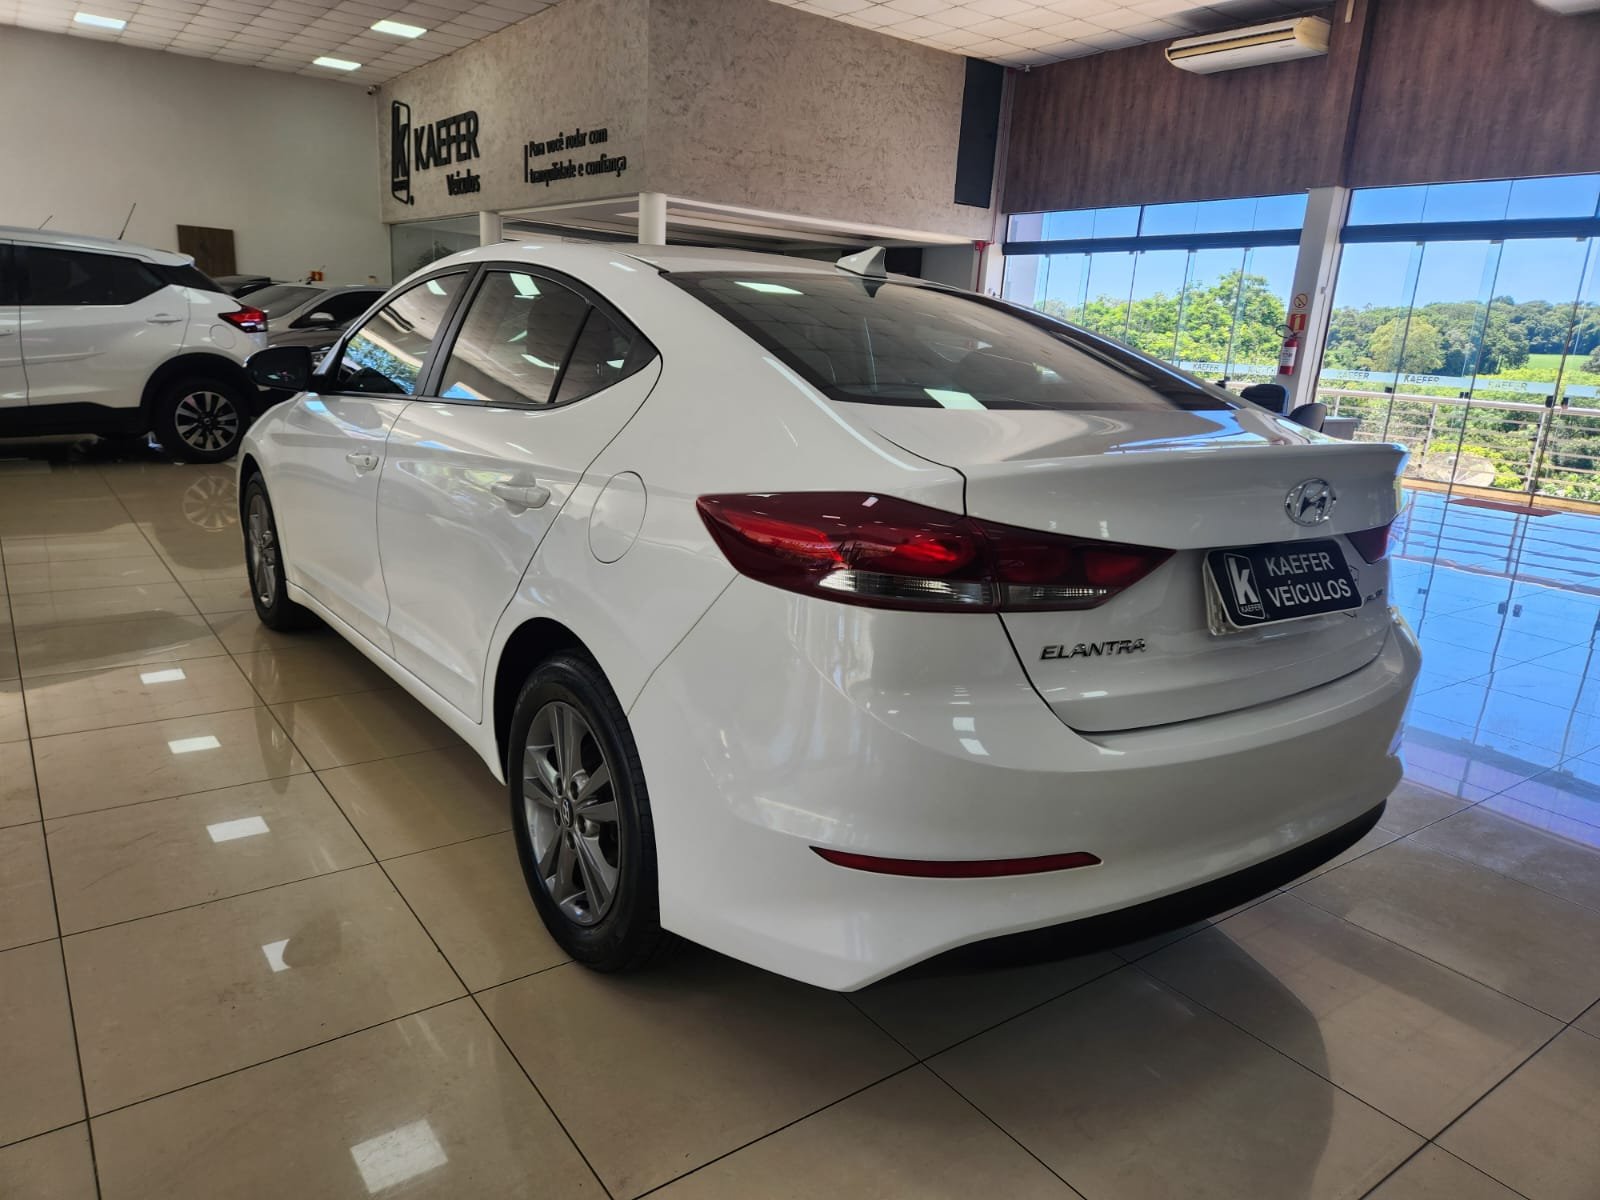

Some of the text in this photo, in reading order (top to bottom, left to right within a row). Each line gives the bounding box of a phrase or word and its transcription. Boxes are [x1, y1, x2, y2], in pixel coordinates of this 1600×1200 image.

[414, 111, 480, 171] KAEFER
[529, 128, 608, 158] Para você rodar com
[577, 163, 584, 177] e
[585, 153, 627, 177] confiança
[1403, 374, 1440, 384] KAEFER
[1265, 552, 1334, 577] KAEFER
[1267, 578, 1351, 608] VEÍCULOS
[1040, 638, 1146, 660] ELANTRA
